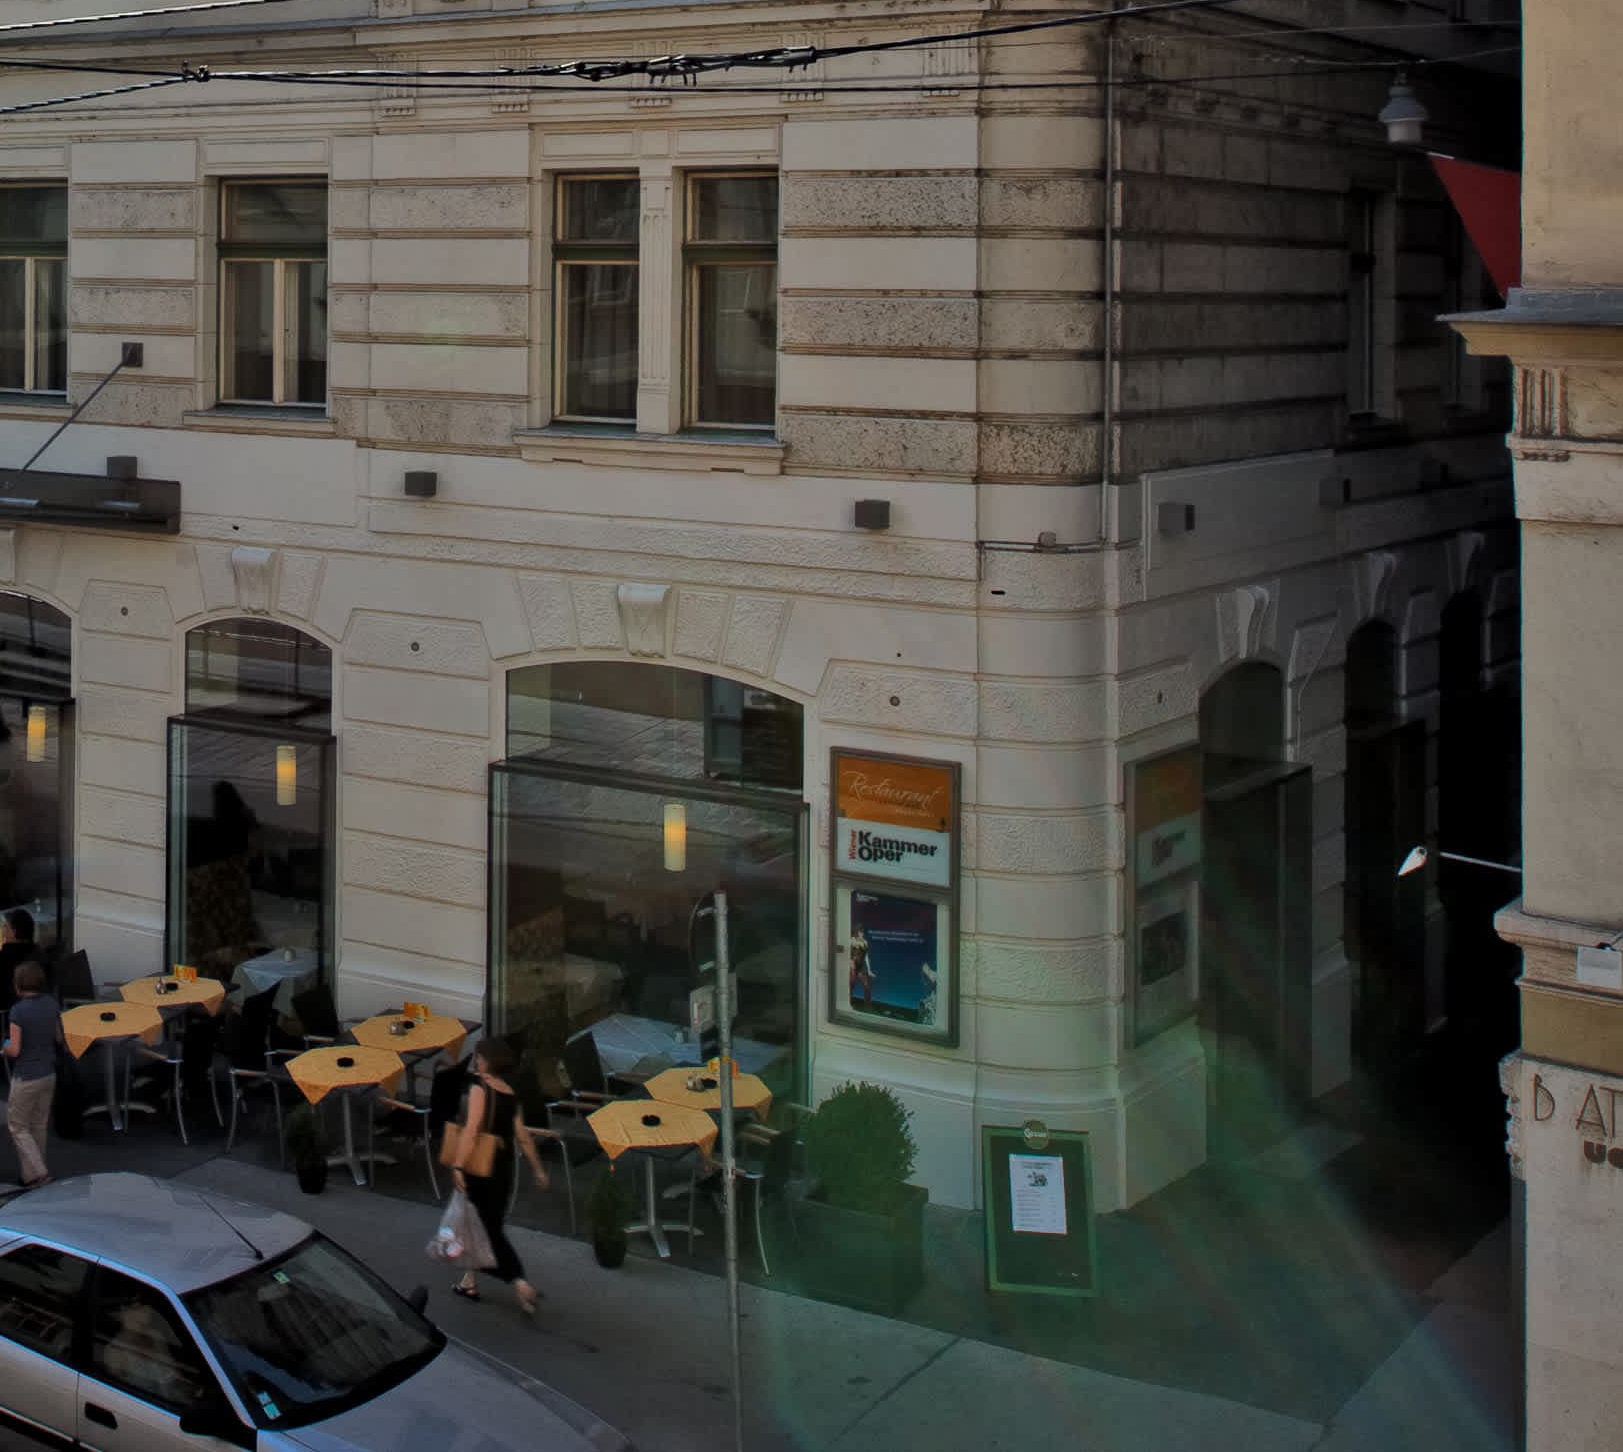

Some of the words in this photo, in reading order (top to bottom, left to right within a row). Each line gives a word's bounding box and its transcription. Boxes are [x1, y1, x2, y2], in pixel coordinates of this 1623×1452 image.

[841, 769, 945, 810] Restaurant
[858, 830, 937, 857] Kammer
[858, 846, 903, 862] Oper
